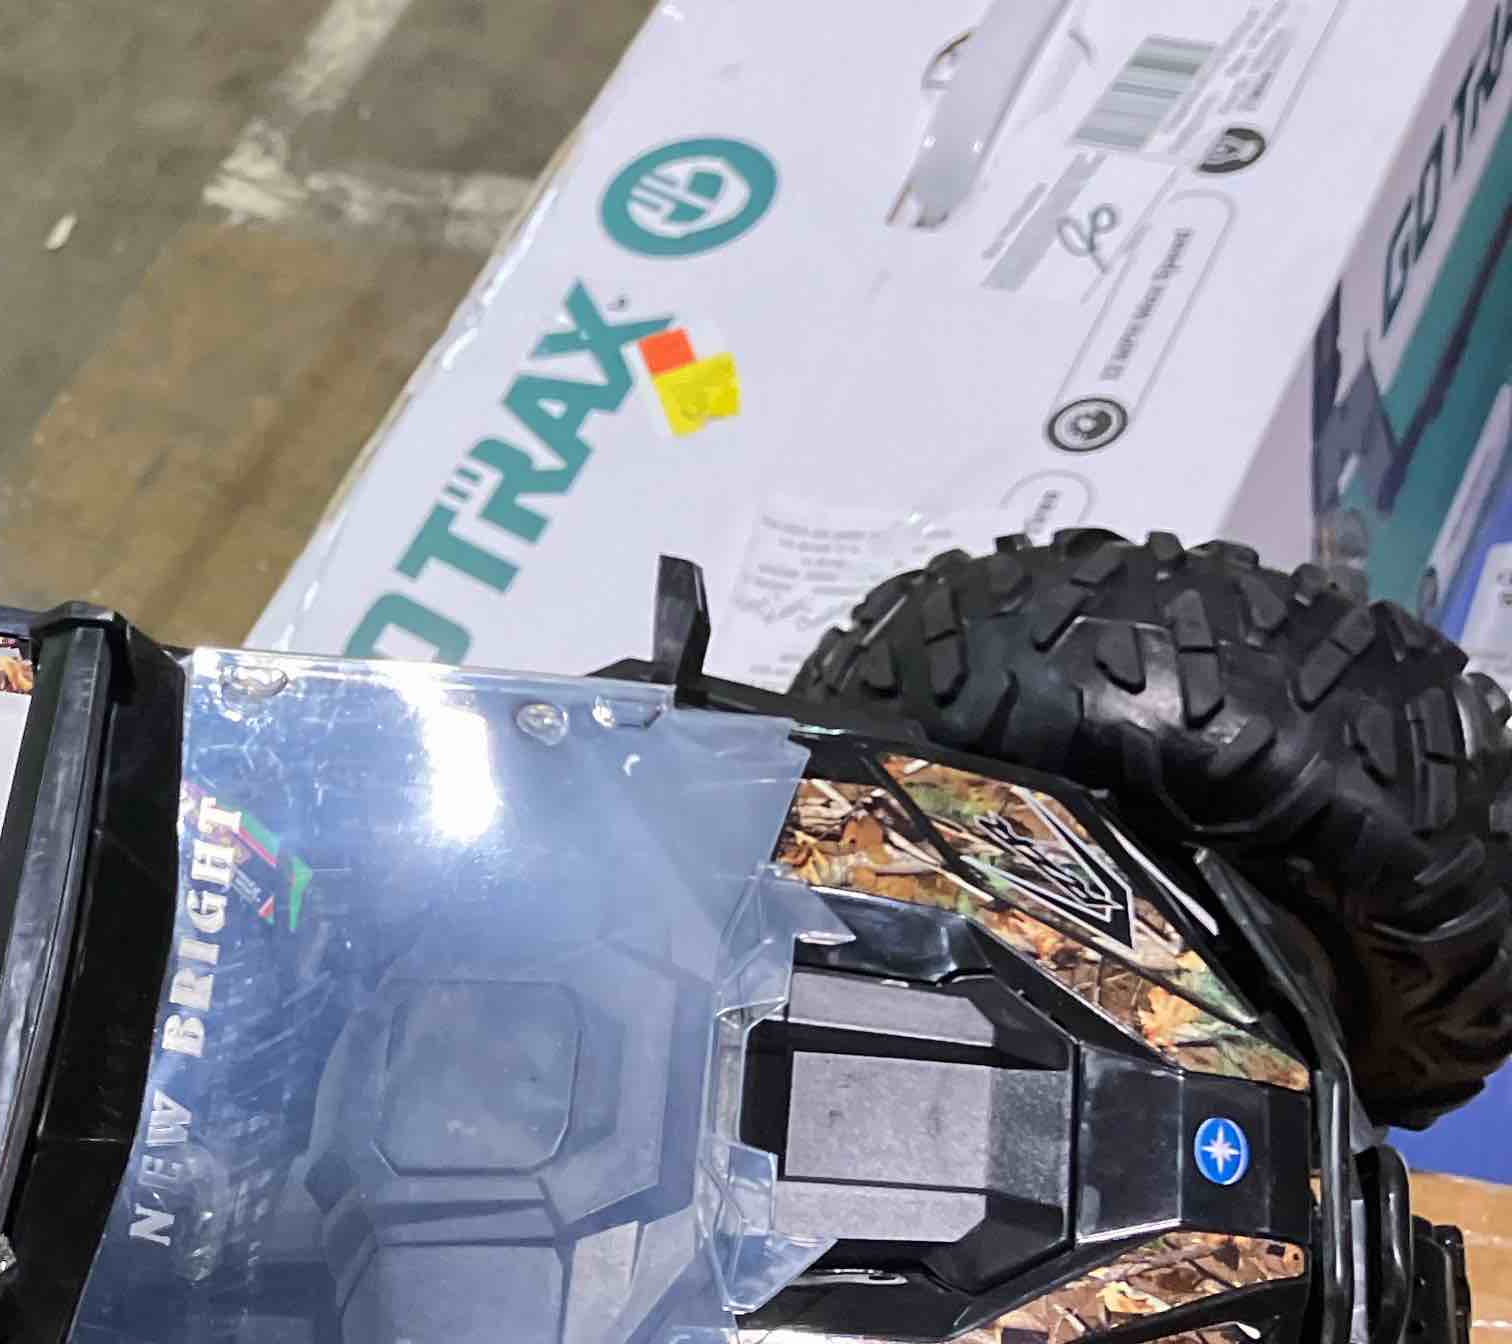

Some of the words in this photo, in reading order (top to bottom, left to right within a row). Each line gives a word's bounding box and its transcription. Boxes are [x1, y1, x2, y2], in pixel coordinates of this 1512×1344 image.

[343, 276, 675, 666] OTRAX
[129, 1088, 192, 1247] NEW
[161, 796, 243, 1058] BRIGHT
